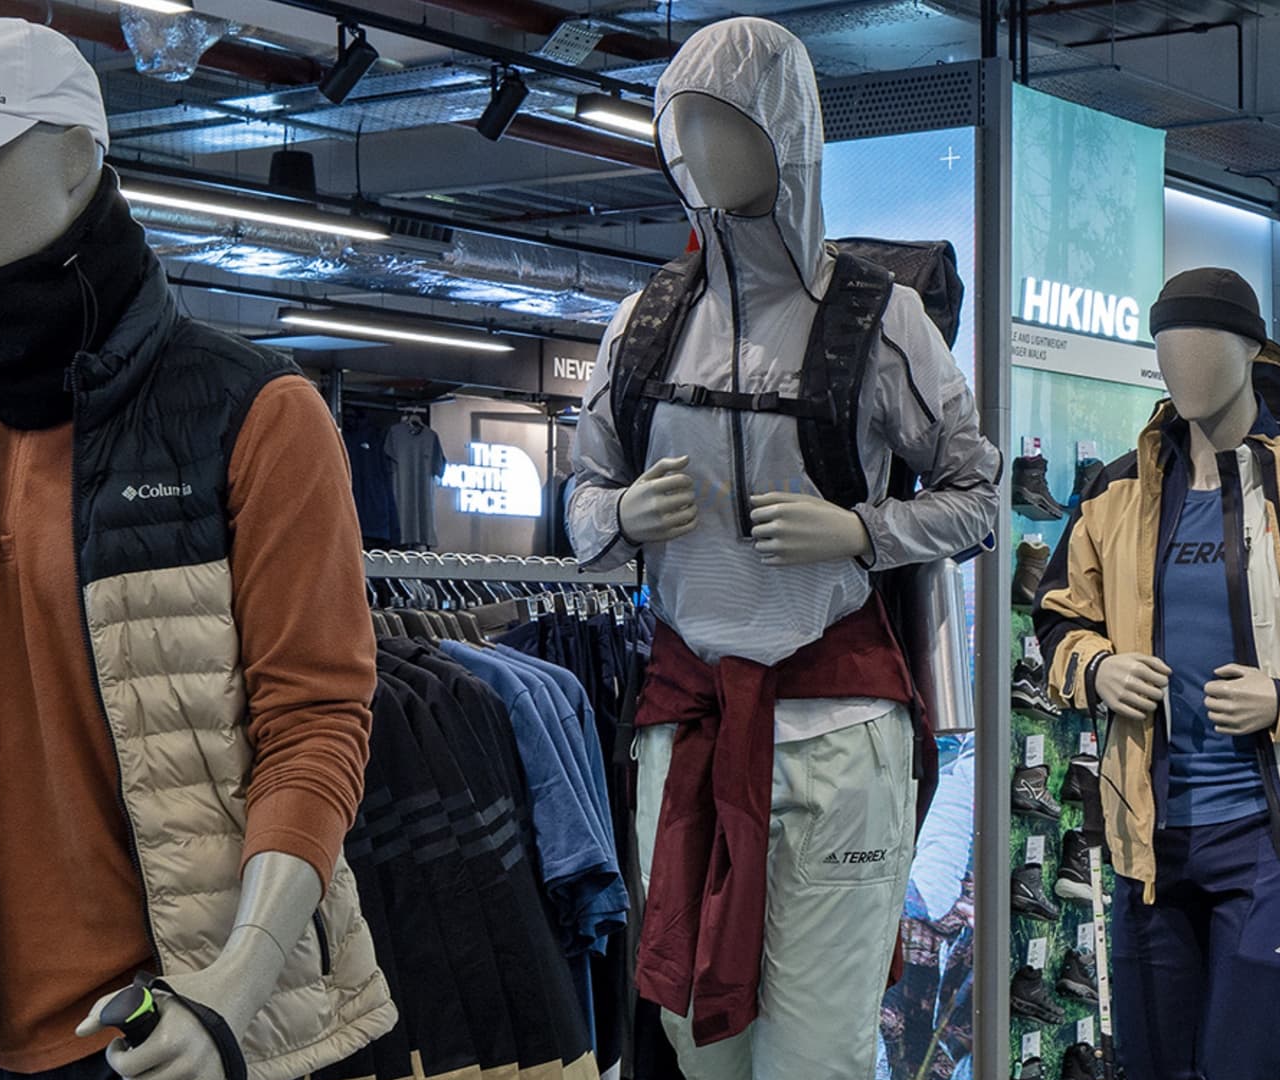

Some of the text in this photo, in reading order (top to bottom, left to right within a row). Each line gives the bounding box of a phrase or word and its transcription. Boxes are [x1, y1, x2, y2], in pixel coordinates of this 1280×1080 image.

[1022, 277, 1140, 342] HIKING
[469, 442, 508, 467] THE
[842, 849, 887, 864] TERREX
